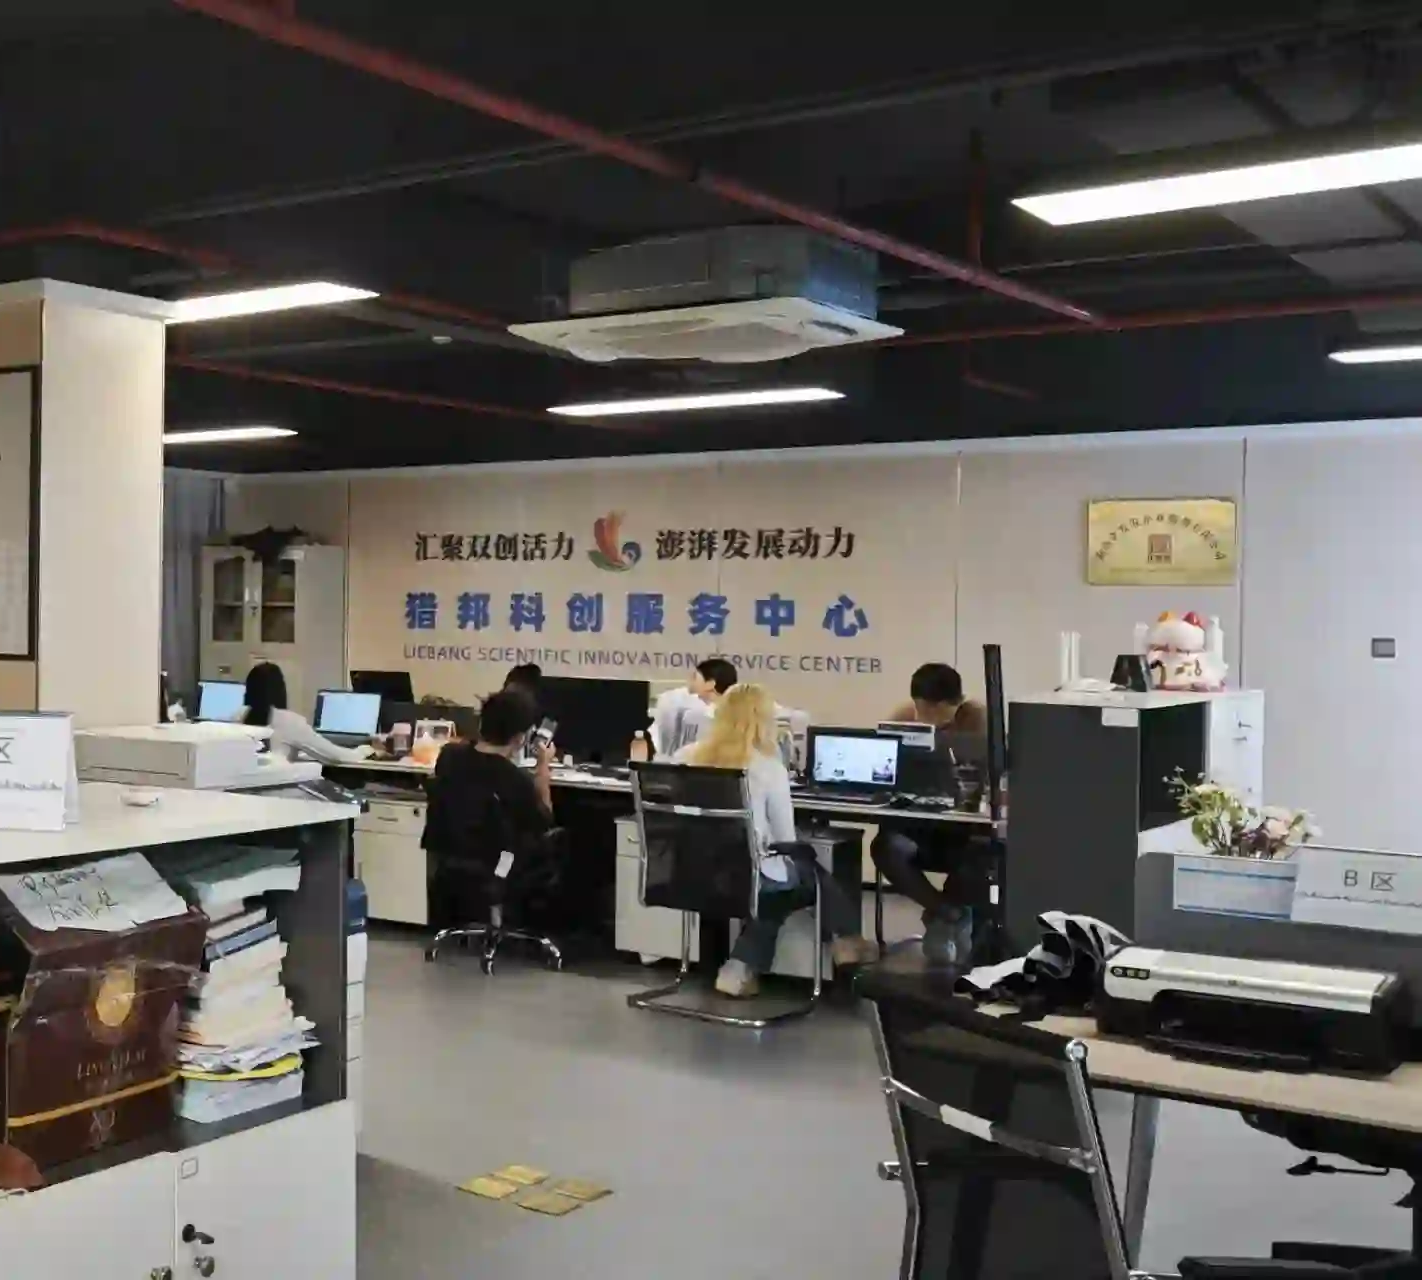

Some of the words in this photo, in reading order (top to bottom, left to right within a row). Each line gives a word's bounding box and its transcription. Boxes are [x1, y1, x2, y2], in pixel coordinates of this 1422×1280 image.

[415, 531, 574, 562] 汇聚双创活力
[656, 526, 856, 560] 澎湃发展动力
[404, 591, 870, 638] 猎邦科创服务中心
[403, 644, 471, 661] LIEBANG
[478, 646, 570, 664] SCIENTIFIC
[579, 650, 698, 670] INNOVATION
[799, 655, 882, 673] CENTER
